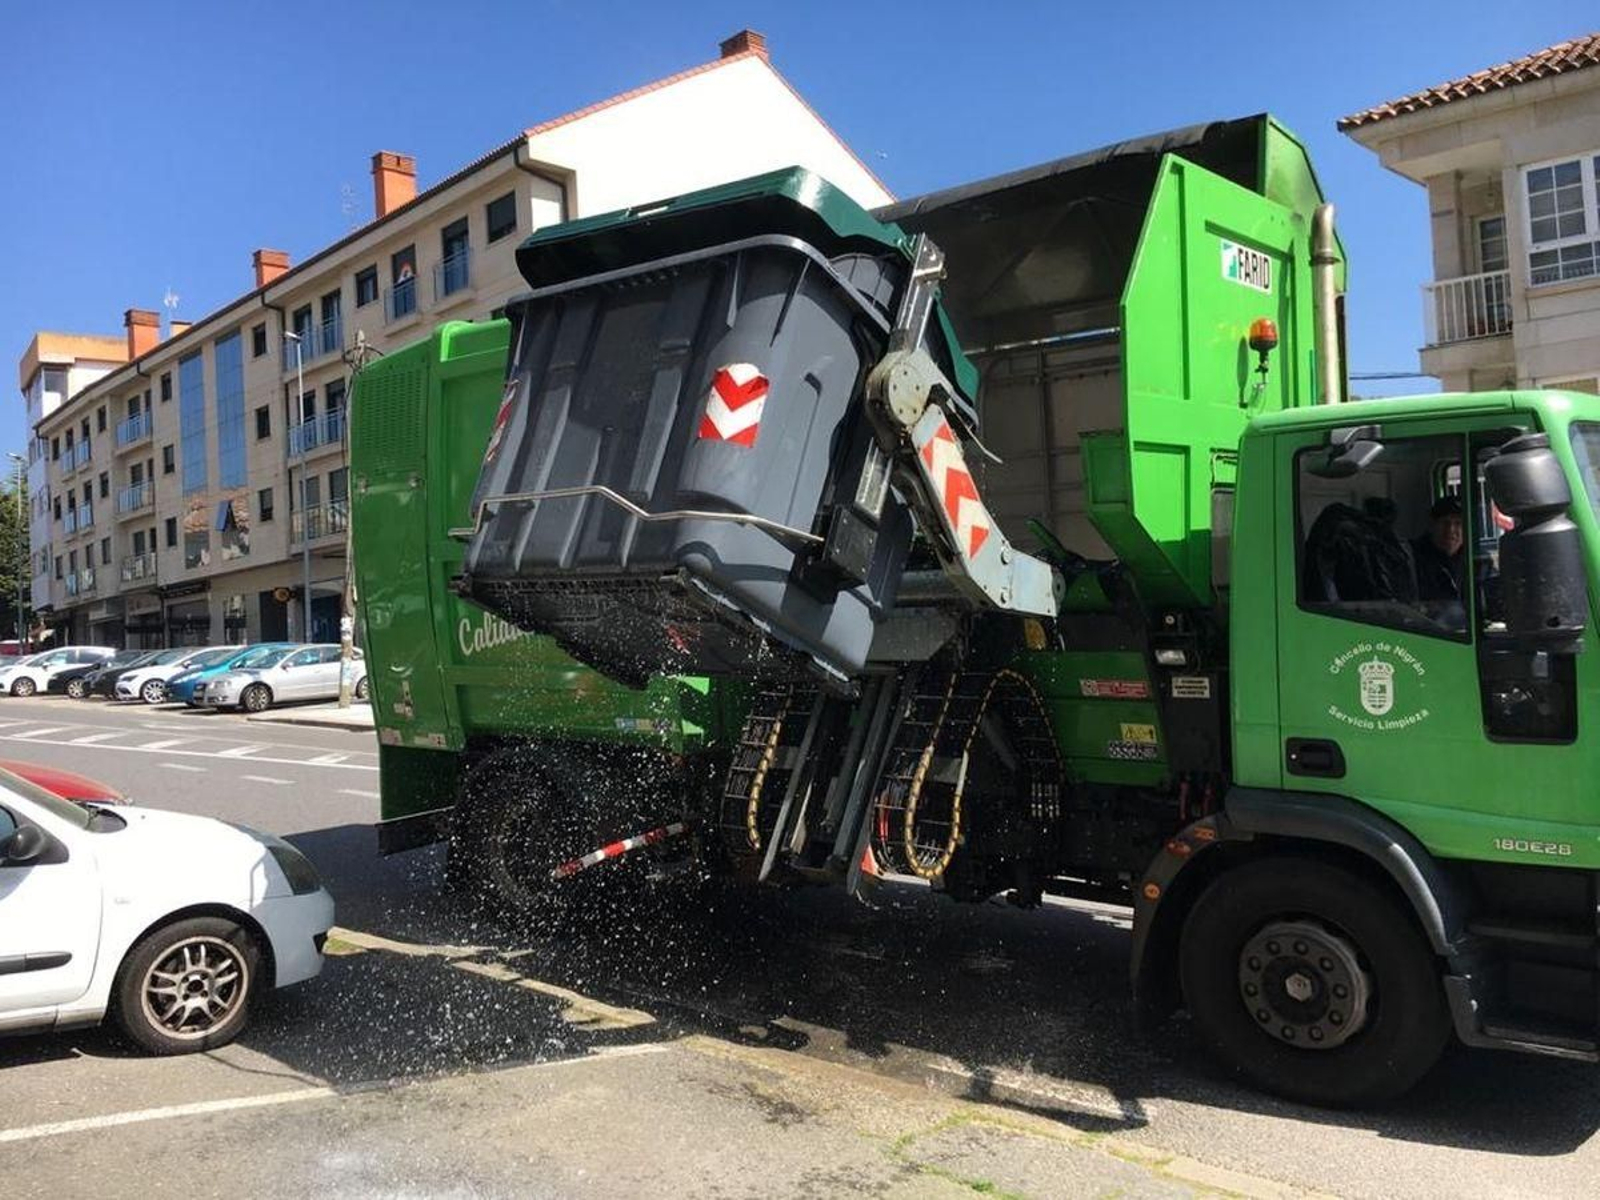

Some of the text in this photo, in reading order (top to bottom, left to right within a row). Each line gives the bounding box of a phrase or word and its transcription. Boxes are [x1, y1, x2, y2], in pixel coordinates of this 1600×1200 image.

[1238, 247, 1270, 290] FARID
[1376, 642, 1391, 653] de
[1328, 704, 1430, 730] Servicio Limpieza
[1493, 838, 1573, 856] 180E28
